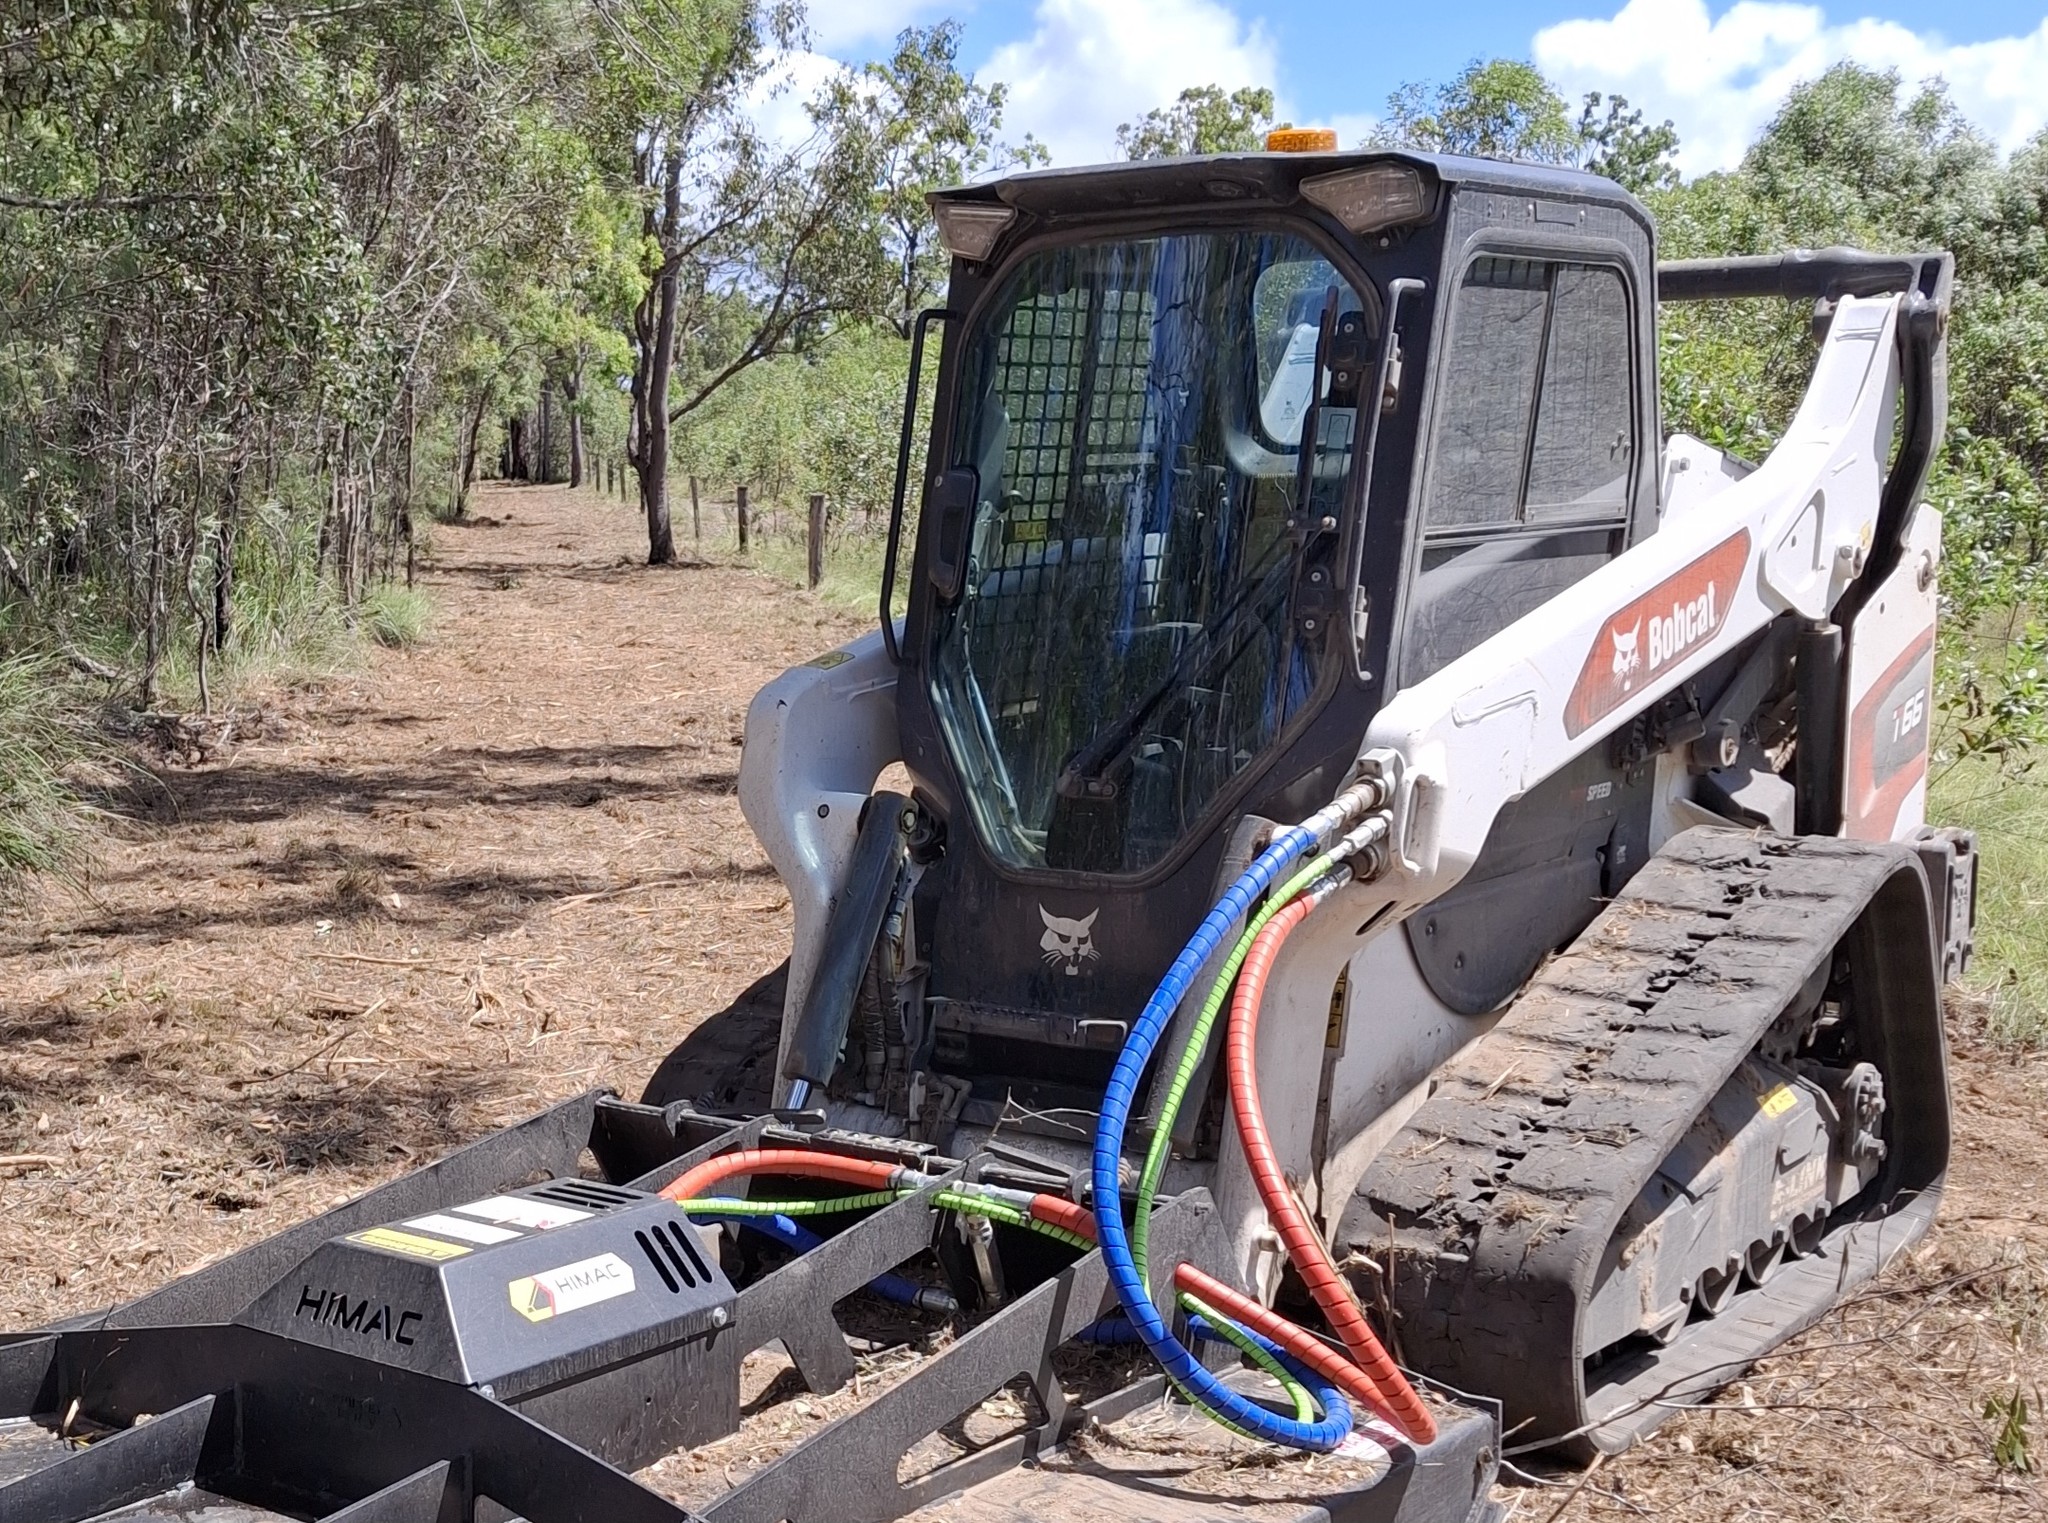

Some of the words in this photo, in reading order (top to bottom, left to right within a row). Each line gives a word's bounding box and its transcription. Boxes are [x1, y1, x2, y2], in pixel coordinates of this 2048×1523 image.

[1649, 580, 1715, 671] Bobcat
[1893, 688, 1925, 743] T66
[1586, 781, 1612, 801] SPEED
[555, 1263, 621, 1294] HIMAC
[294, 1285, 423, 1345] HIMAC
